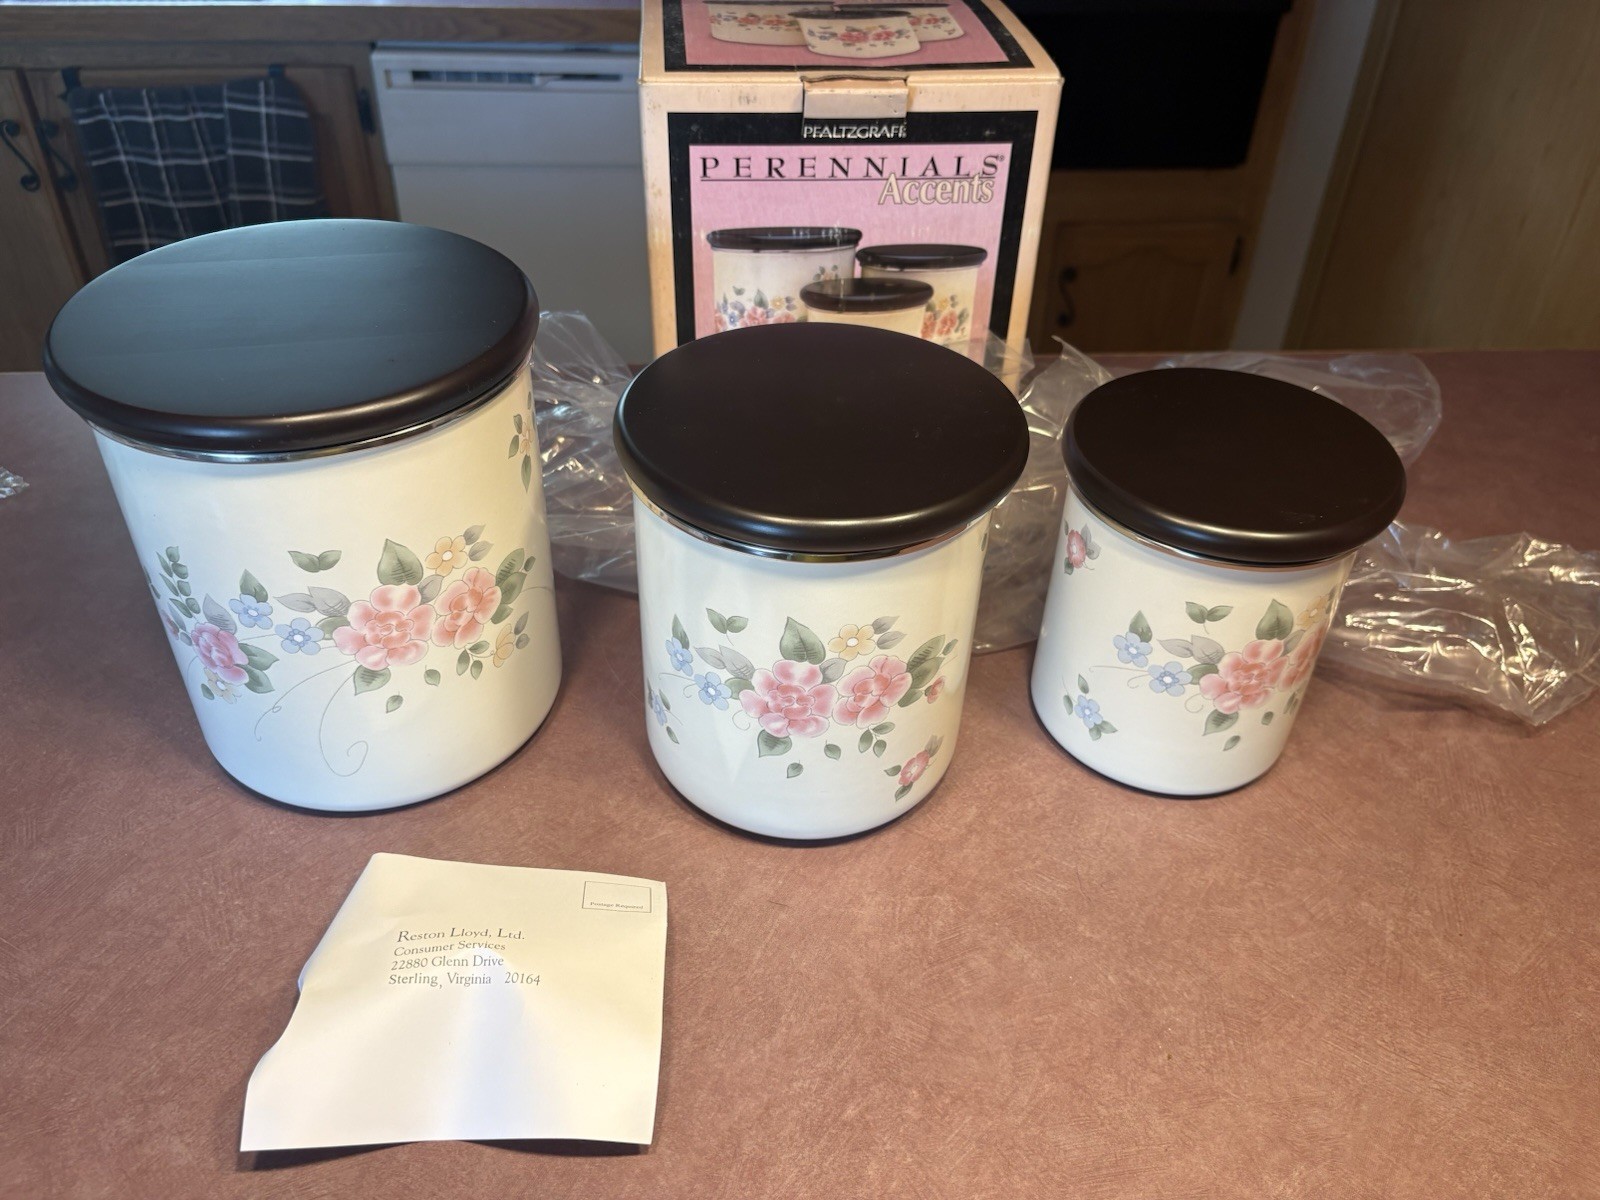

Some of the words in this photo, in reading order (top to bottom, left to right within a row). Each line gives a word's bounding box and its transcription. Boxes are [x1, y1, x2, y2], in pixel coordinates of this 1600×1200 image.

[878, 172, 996, 205] Accents
[397, 930, 445, 942] Reston
[450, 927, 492, 938] Lloyd,
[497, 928, 525, 940] Ltd.
[394, 943, 453, 957] Consumer
[457, 940, 506, 950] Services
[391, 958, 428, 971] 22880
[431, 956, 469, 967] Glenn
[473, 955, 504, 967] Drive
[388, 973, 443, 989] Sterling,
[447, 972, 492, 987] Virginia
[504, 972, 541, 986] 20164
